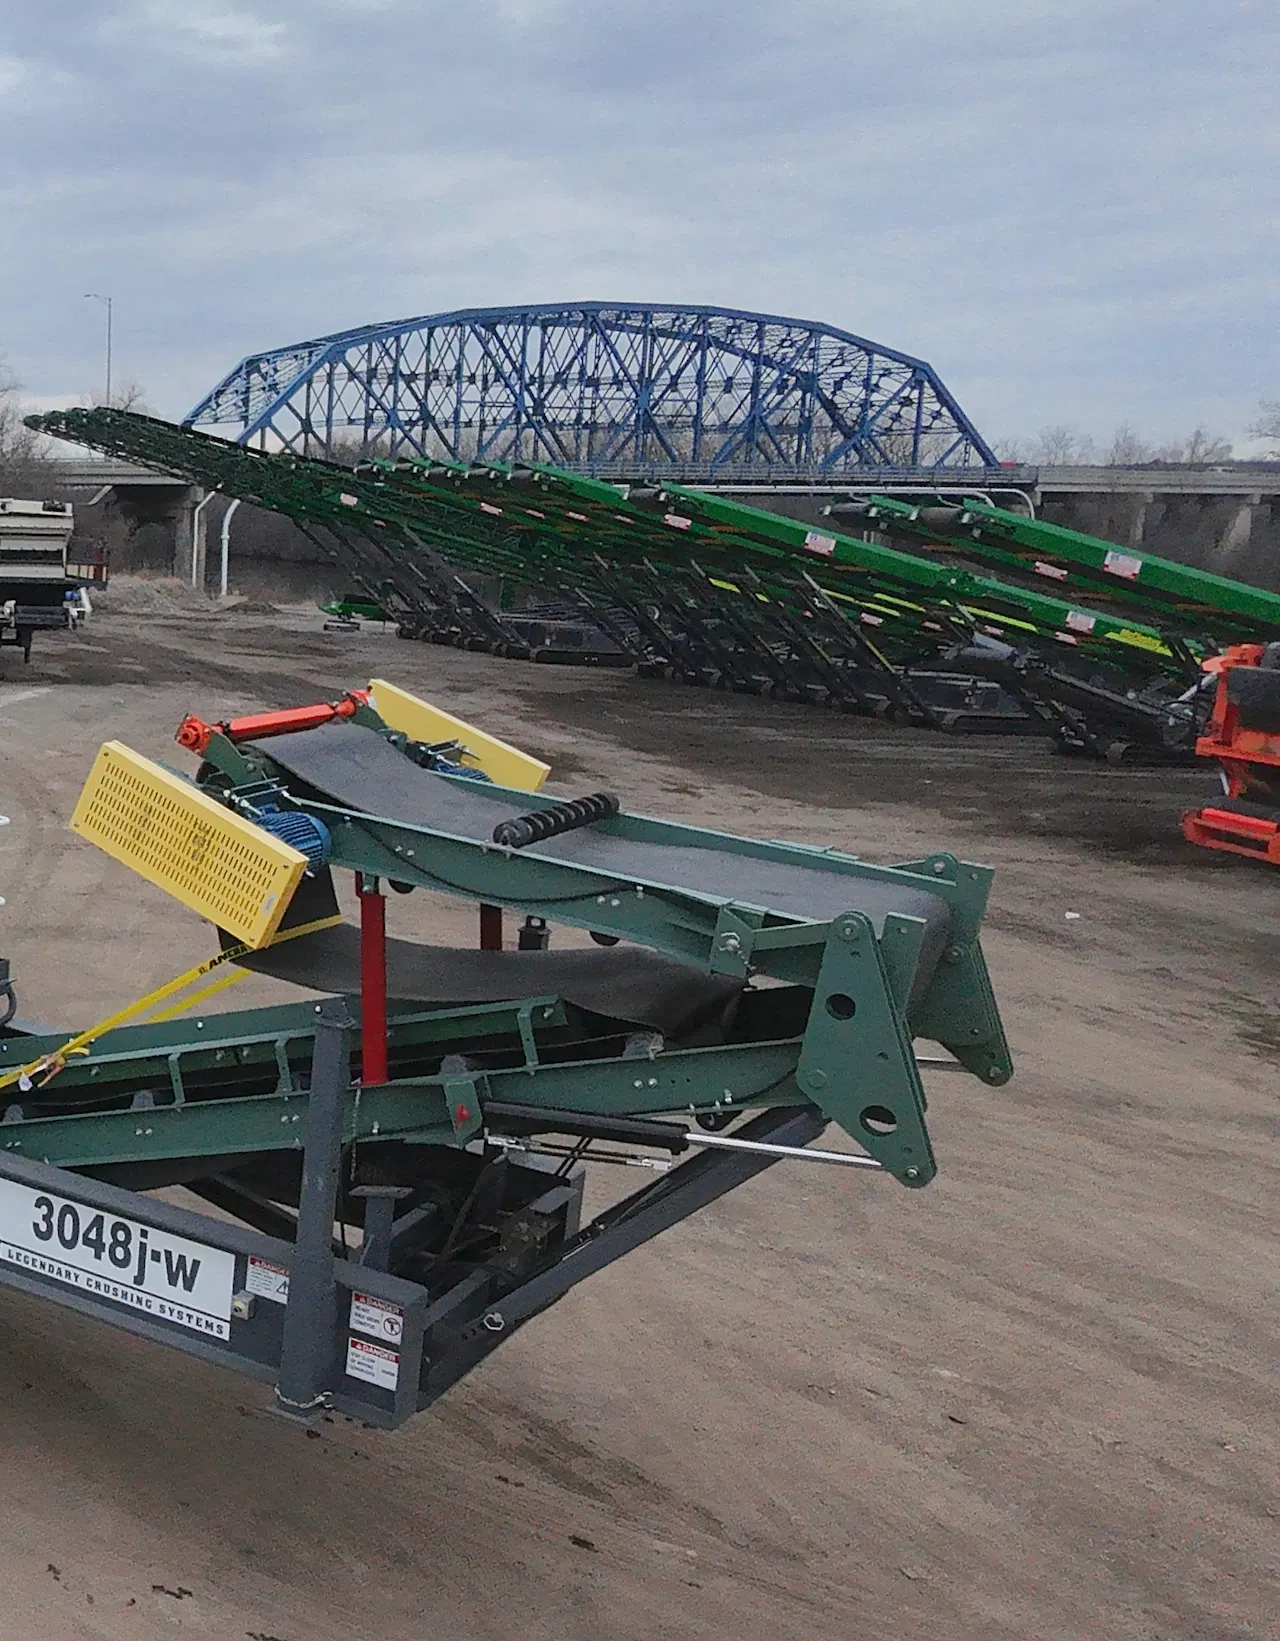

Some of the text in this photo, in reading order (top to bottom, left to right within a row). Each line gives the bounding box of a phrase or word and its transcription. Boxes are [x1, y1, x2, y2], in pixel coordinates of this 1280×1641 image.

[7, 1248, 225, 1336] LEGENDARY CRUSHING SYSTEMS
[365, 1297, 401, 1316] DANGER
[362, 1344, 397, 1362] DANGER
